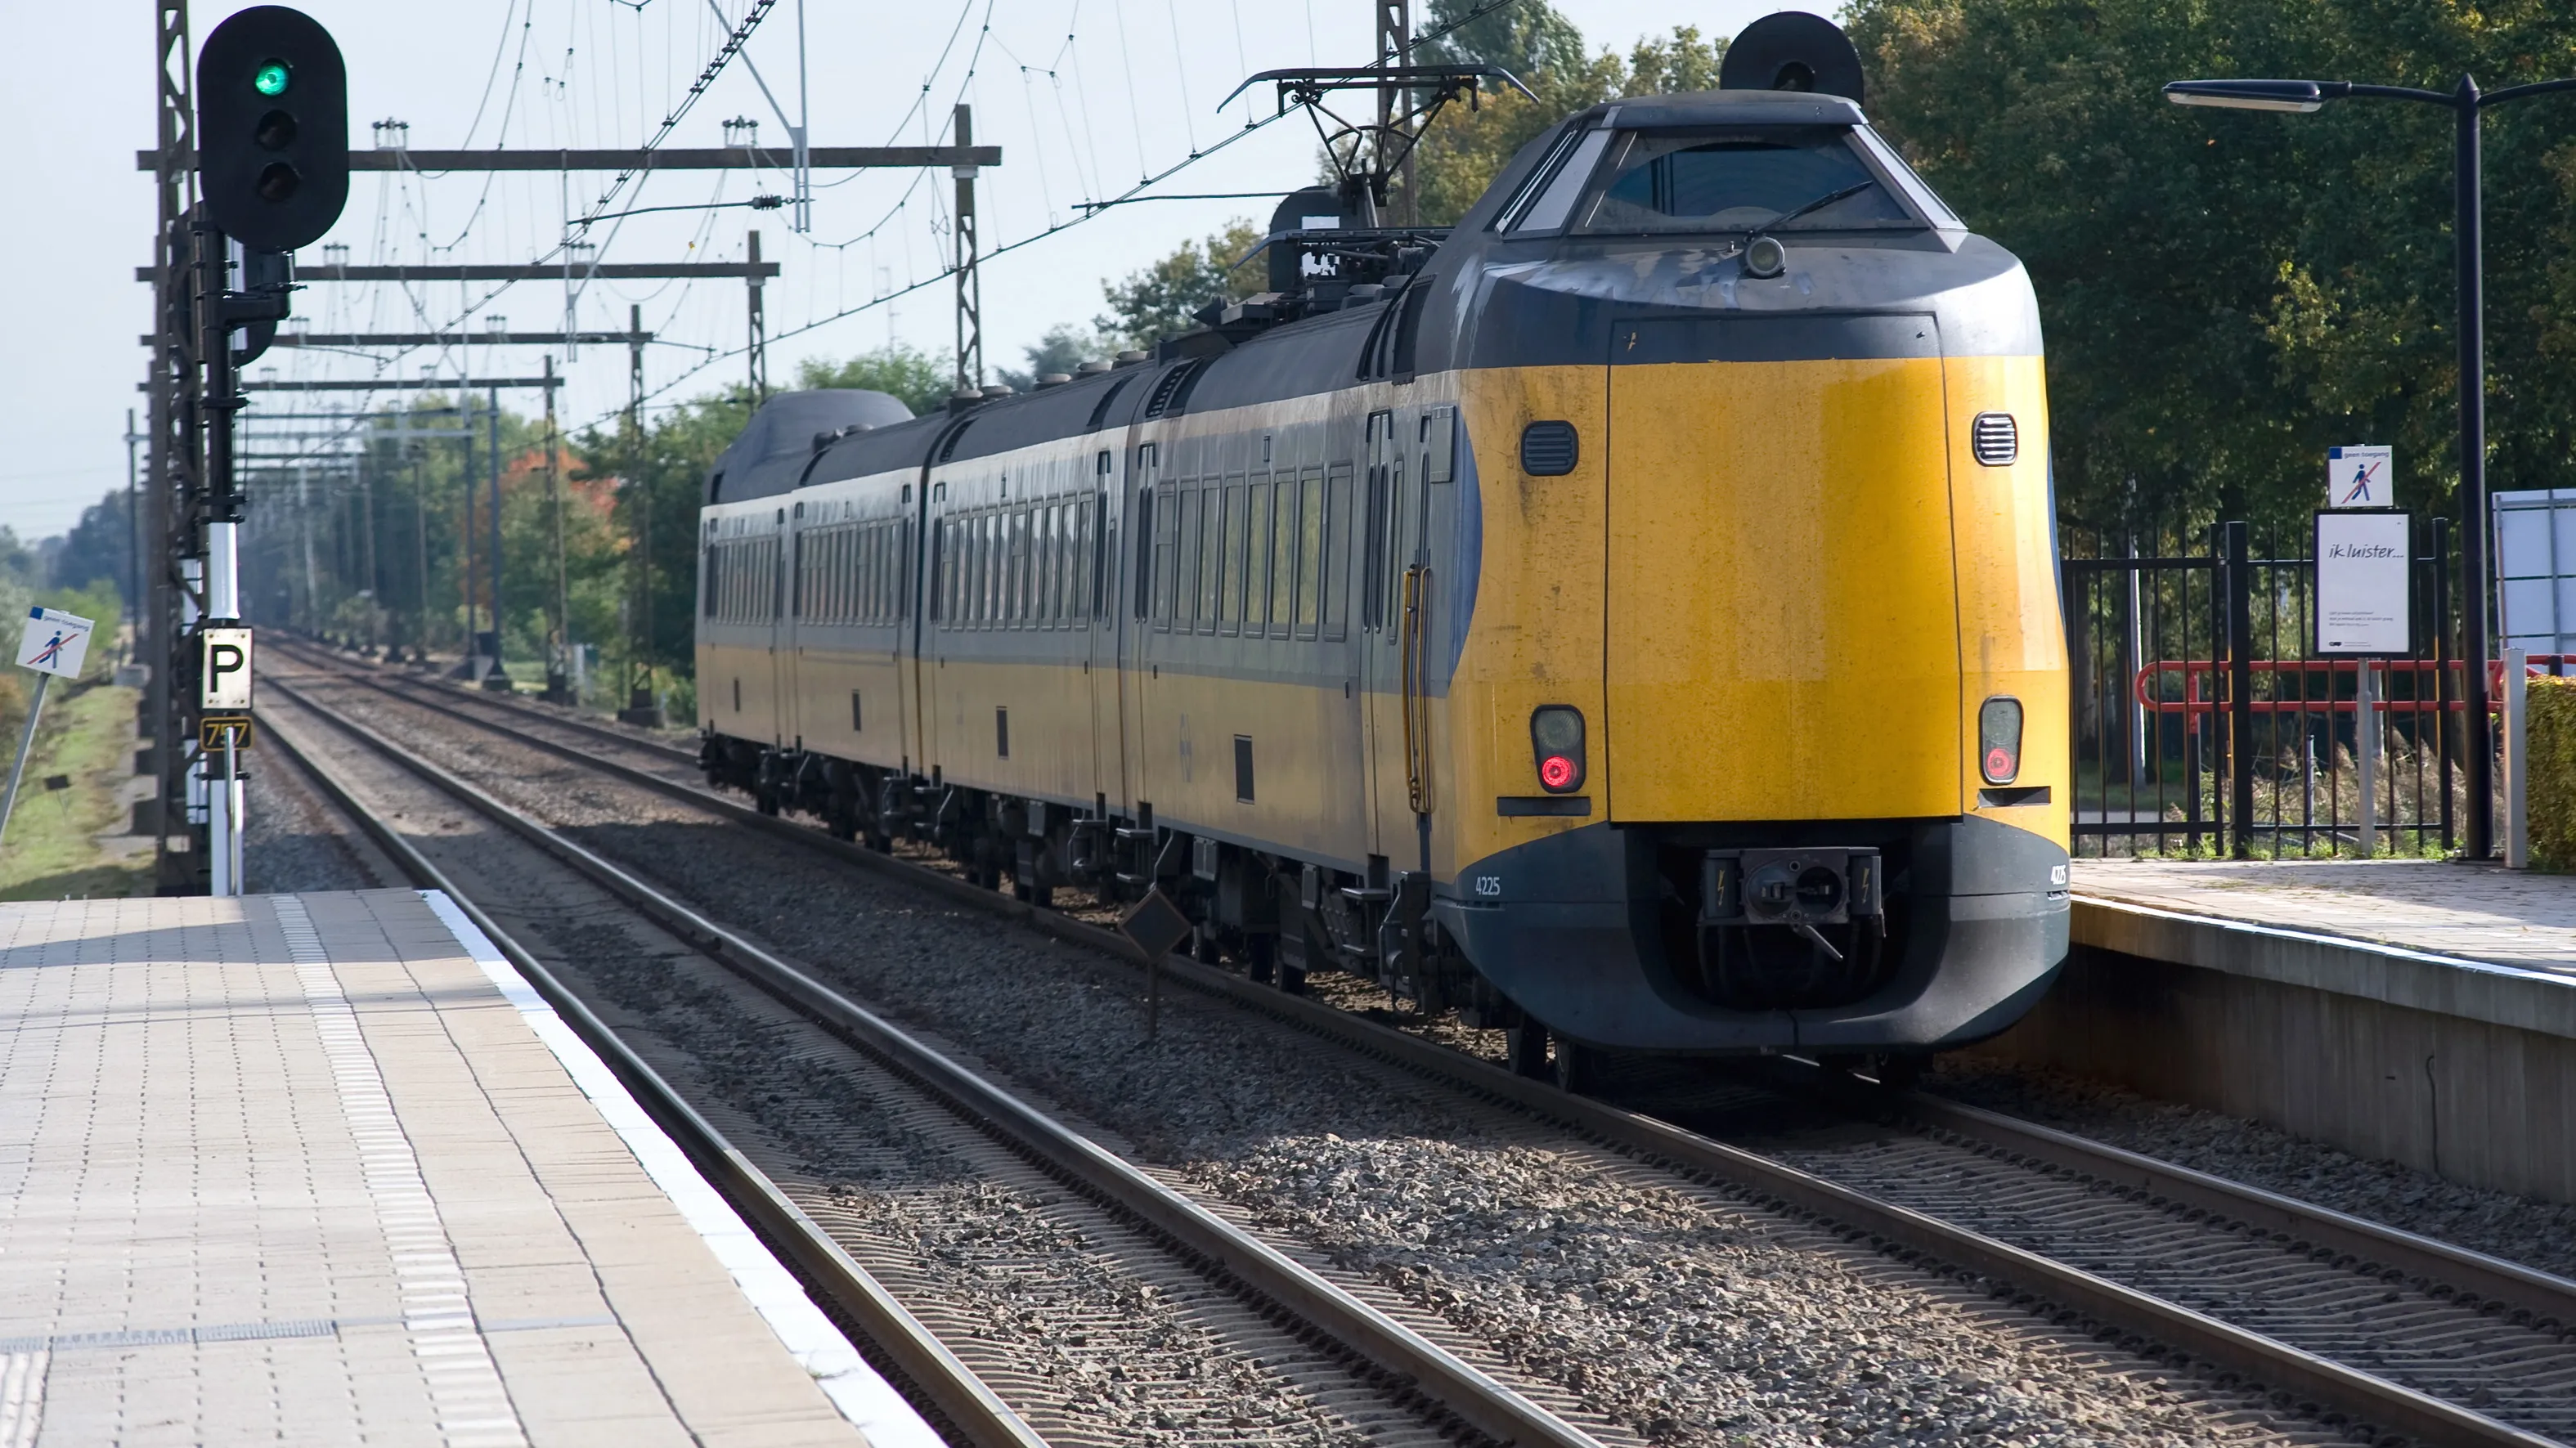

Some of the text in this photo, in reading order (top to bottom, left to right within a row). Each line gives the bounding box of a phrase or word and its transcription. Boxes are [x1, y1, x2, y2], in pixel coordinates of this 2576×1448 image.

[2329, 544, 2404, 558] ik luister...
[210, 644, 244, 693] P
[1475, 876, 1501, 895] 4225
